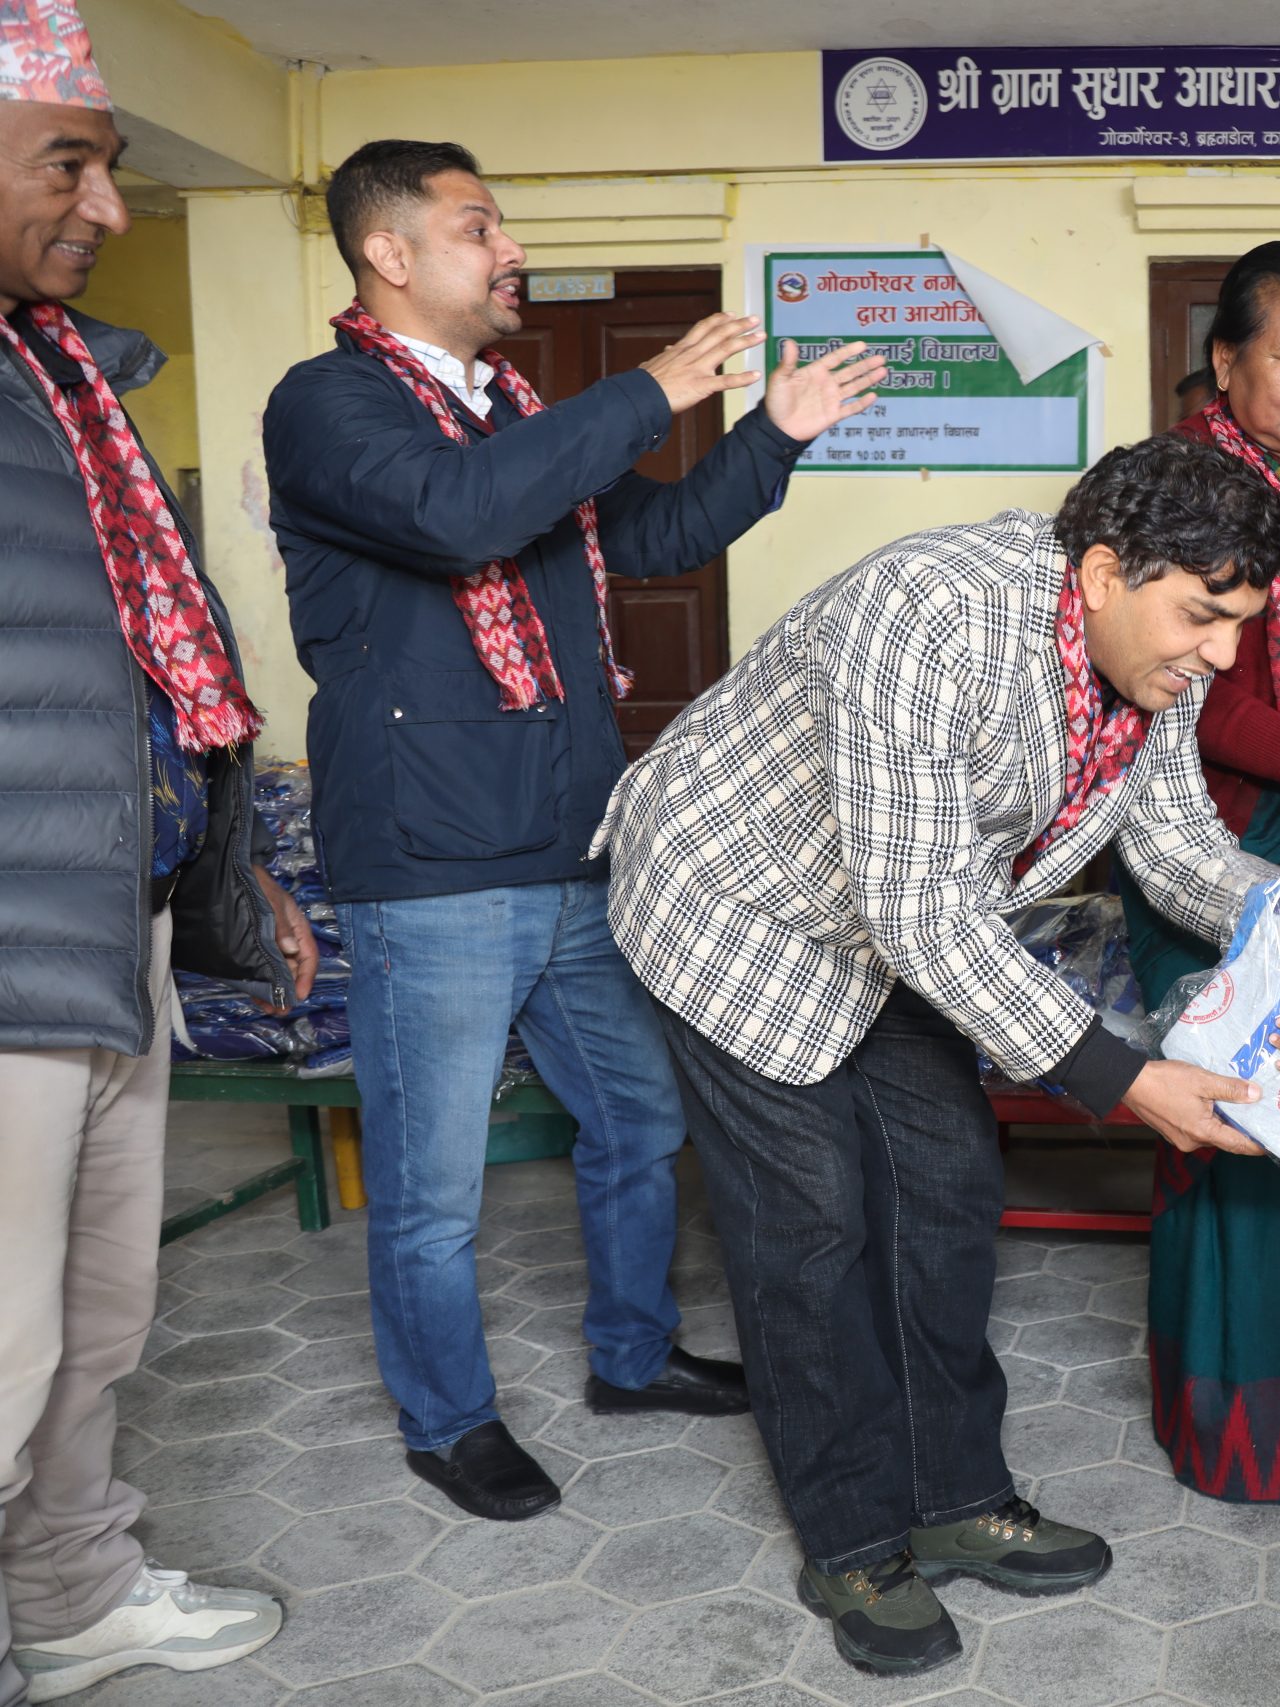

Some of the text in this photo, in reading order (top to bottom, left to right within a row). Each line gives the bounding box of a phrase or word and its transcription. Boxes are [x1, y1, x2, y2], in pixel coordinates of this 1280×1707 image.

[937, 56, 982, 113] श्री
[991, 68, 1062, 115] ग्राम
[1072, 67, 1166, 120] सुधार
[816, 270, 917, 293] गोकर्णेश्वर
[856, 305, 897, 327] द्वारा
[920, 337, 1001, 362] विद्यालय
